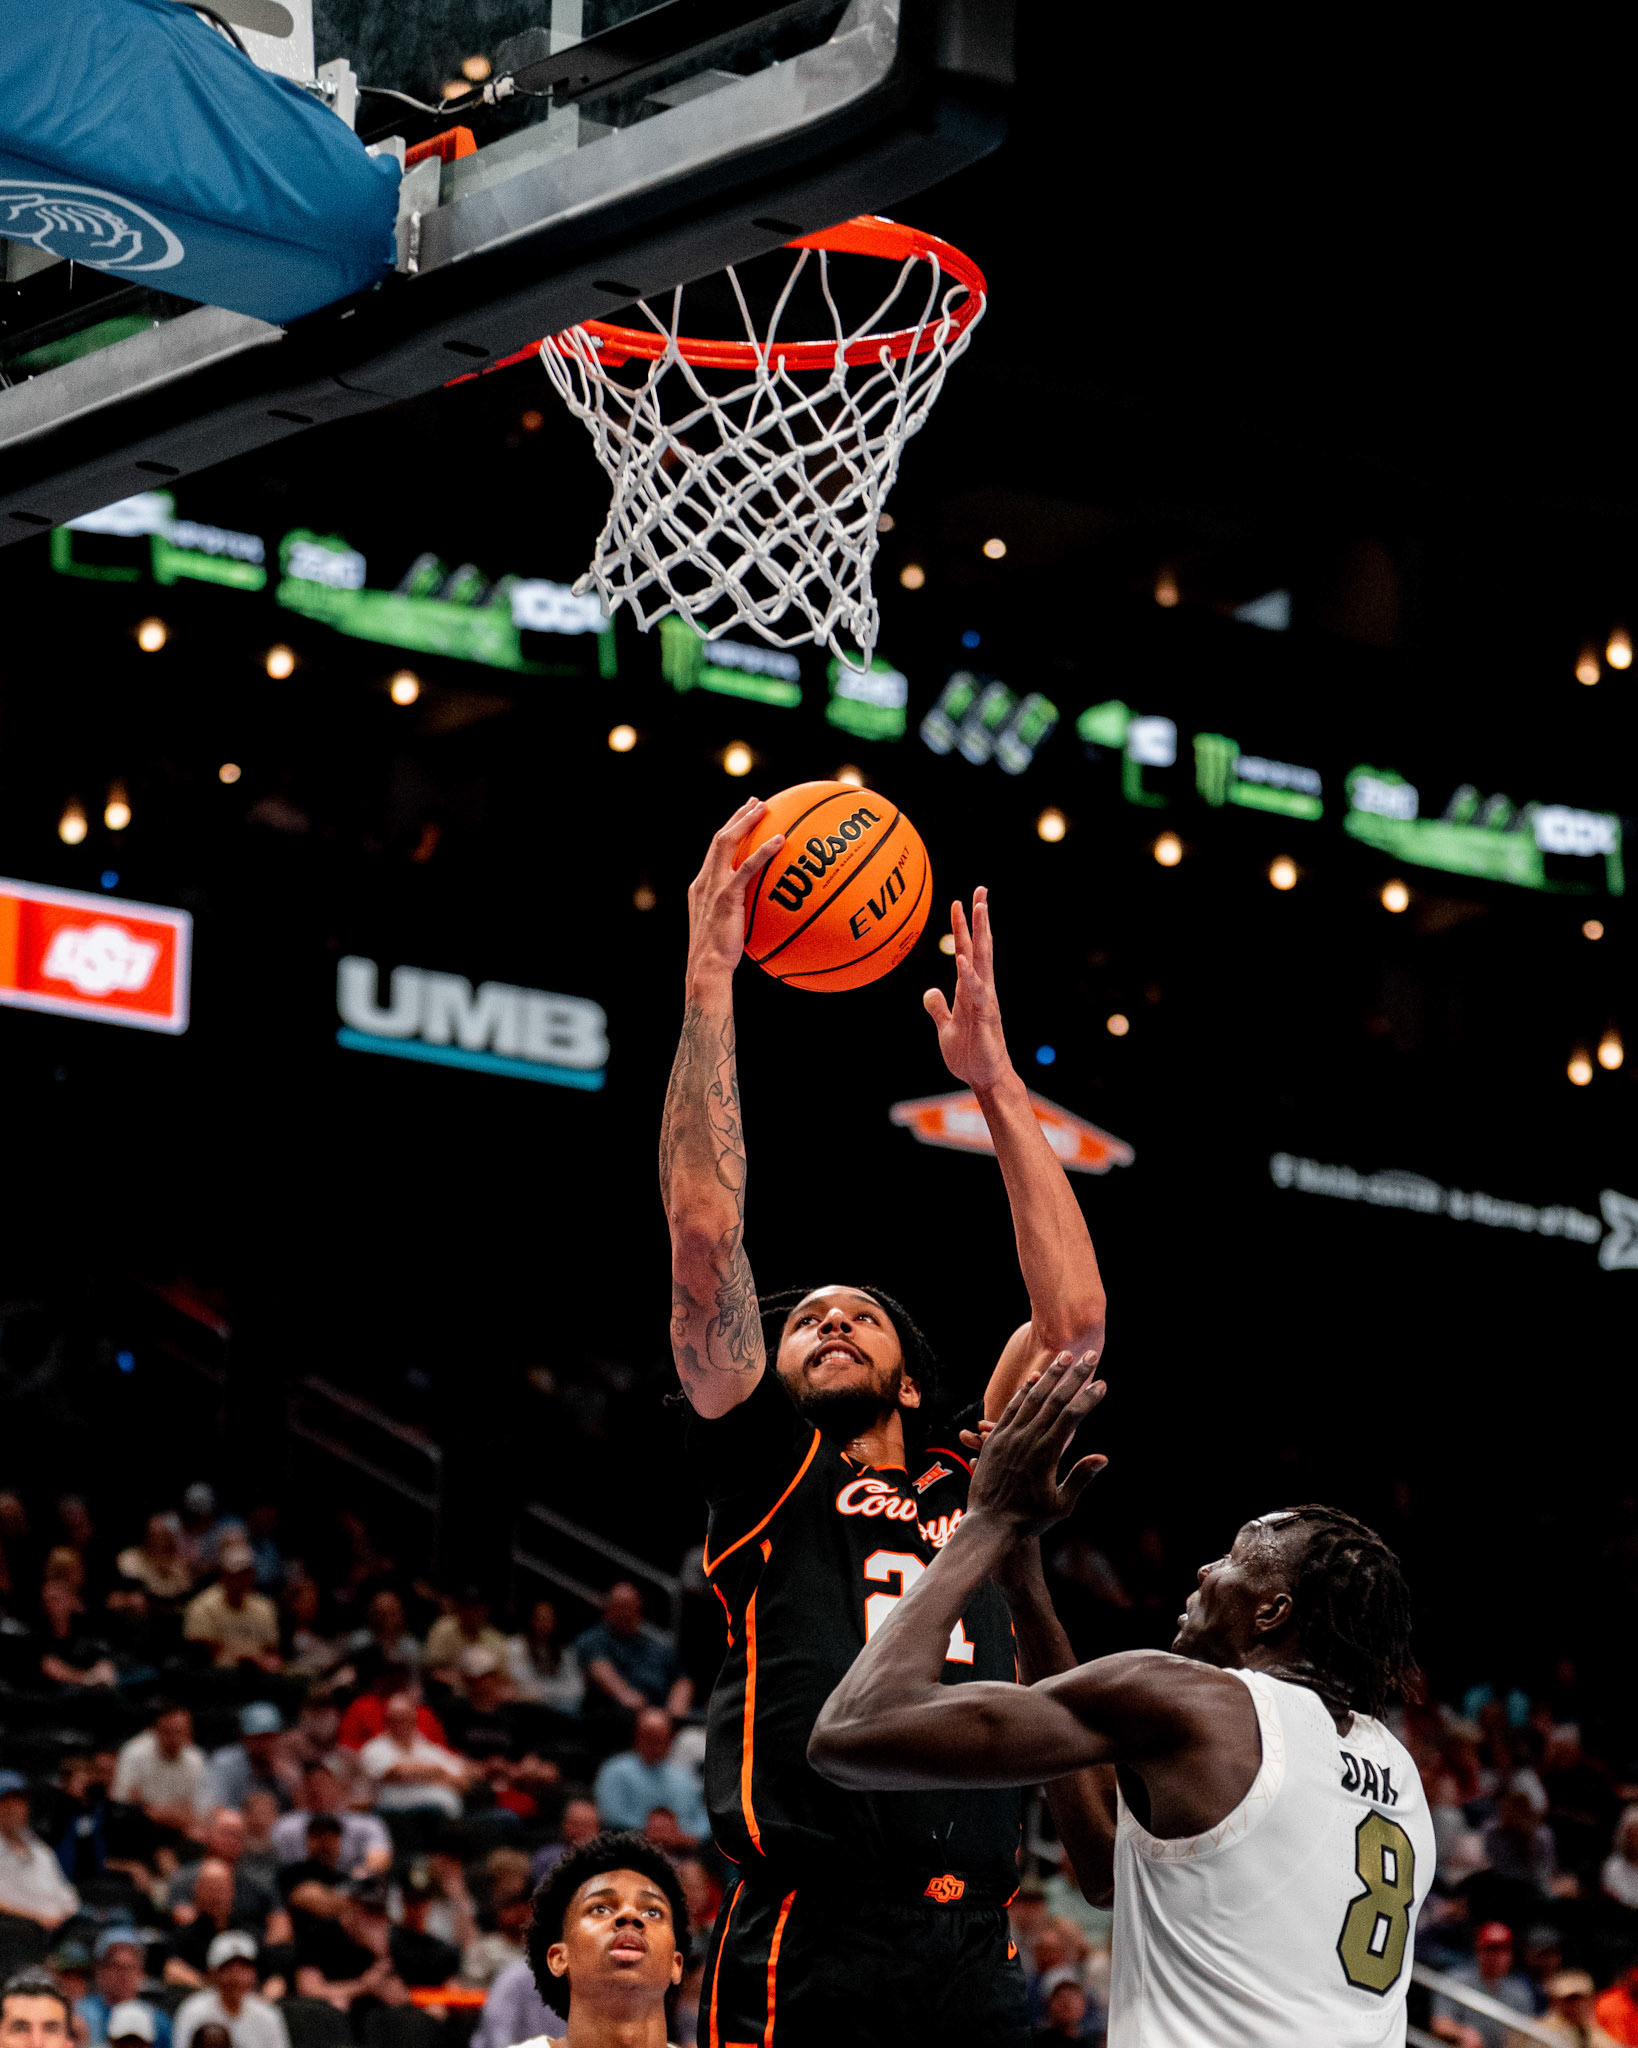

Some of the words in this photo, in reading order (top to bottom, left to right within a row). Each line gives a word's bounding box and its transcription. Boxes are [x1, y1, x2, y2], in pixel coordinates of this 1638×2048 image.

[768, 807, 880, 912] Wilson
[337, 954, 610, 1071] UMB
[923, 1874, 965, 1903] OSU
[1336, 1809, 1415, 1997] 8
